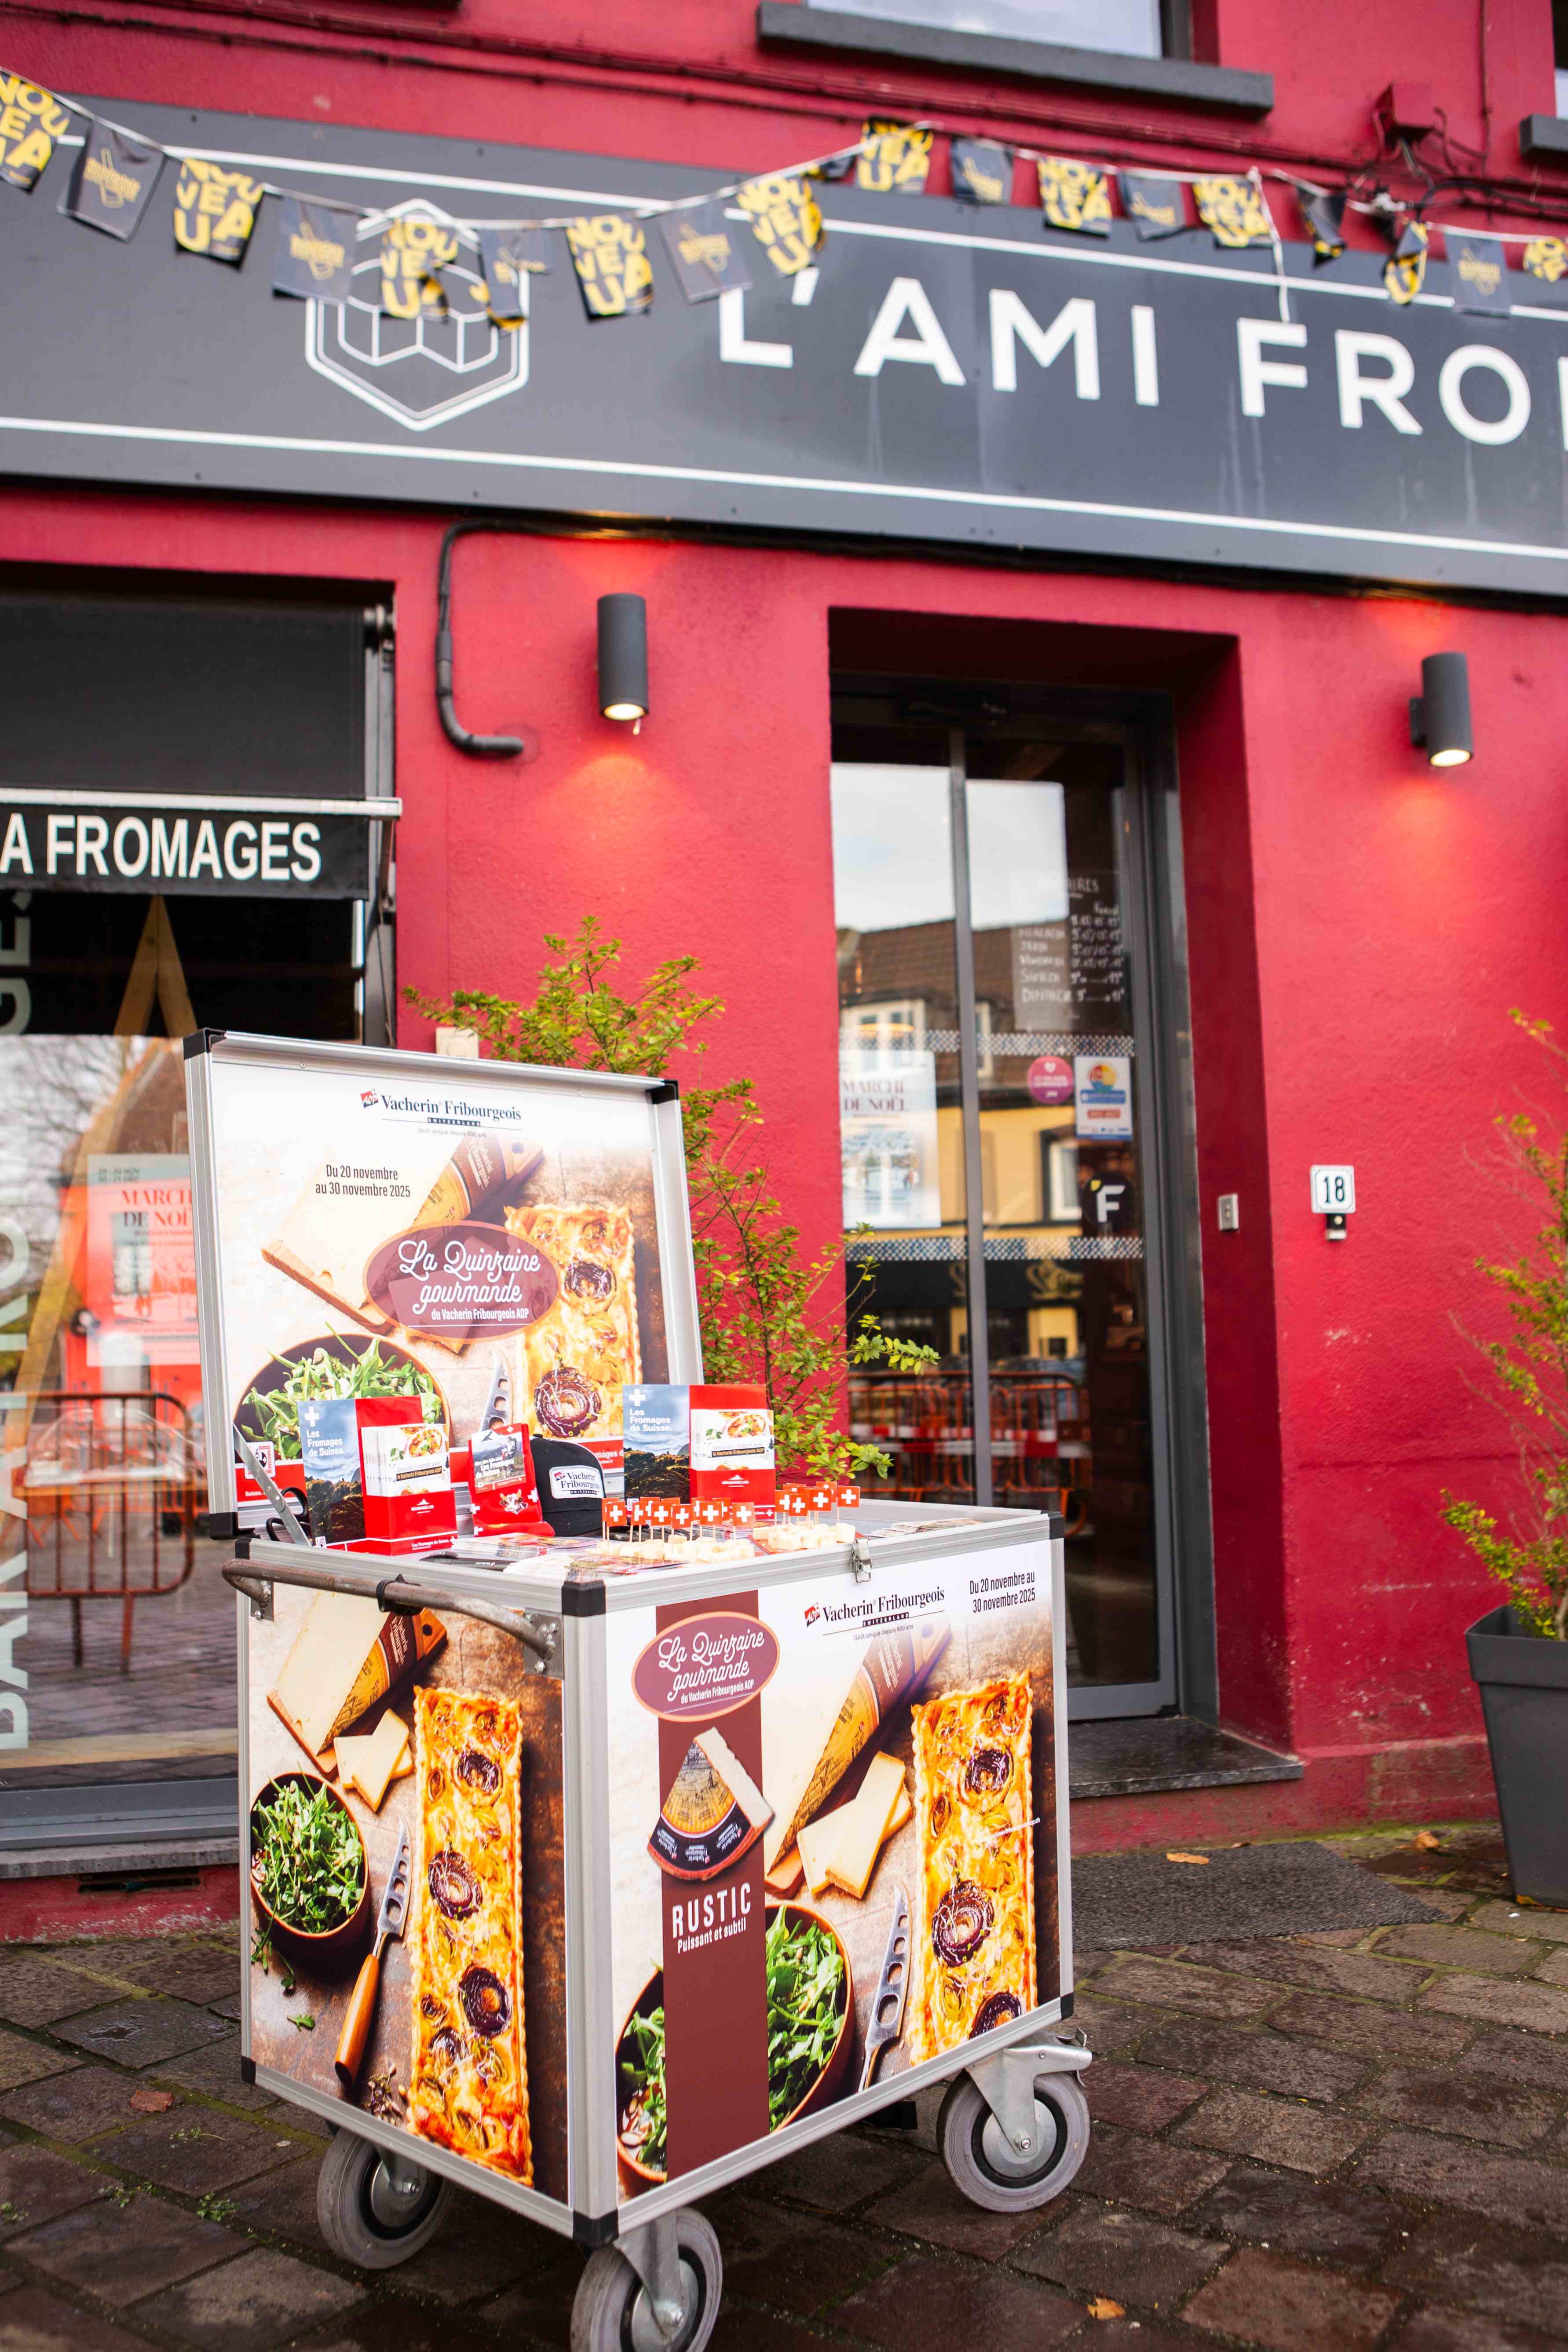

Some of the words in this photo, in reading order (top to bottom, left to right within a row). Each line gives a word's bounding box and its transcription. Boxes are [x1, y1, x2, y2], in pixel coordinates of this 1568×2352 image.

[1236, 317, 1568, 451] FRO
[46, 815, 322, 882] FROMAGES
[445, 1100, 521, 1122] Fribourgeois
[428, 1118, 480, 1127] SWITZERLAND
[326, 1164, 338, 1177] Du
[340, 1165, 351, 1178] 20
[353, 1167, 398, 1180] novembre
[122, 1189, 192, 1205] MARCH
[315, 1184, 327, 1194] au
[329, 1182, 340, 1195] 30
[343, 1183, 387, 1196] novembre
[389, 1185, 410, 1197] 2025
[1323, 1174, 1345, 1204] 18
[123, 1211, 148, 1227] DE
[398, 1240, 438, 1281] La
[443, 1240, 541, 1283] Quinzaine
[412, 1273, 523, 1315] gourmande
[431, 1309, 441, 1320] du
[441, 1308, 472, 1320] Vacherin
[473, 1308, 515, 1322] Fribourgeois
[516, 1308, 529, 1319] AOP
[629, 1416, 671, 1426] Fromages
[306, 1429, 320, 1438] Les
[307, 1438, 343, 1448] Fromages
[308, 1449, 318, 1457] de
[319, 1447, 346, 1456] Suisse.
[969, 1580, 979, 1595] Du
[980, 1578, 989, 1593] 20
[991, 1572, 1025, 1591] novembre
[1026, 1572, 1035, 1584] au
[878, 1586, 945, 1614] Fribourgeois
[972, 1598, 982, 1613] 30
[983, 1592, 1018, 1612] novembre
[1019, 1588, 1036, 1604] 2025
[863, 1611, 909, 1627] SWITZERLAND
[854, 1633, 865, 1642] Goût
[866, 1630, 881, 1640] unique
[881, 1628, 896, 1636] depuis
[658, 1635, 687, 1673] La
[691, 1628, 765, 1666] Quinzaine
[667, 1650, 750, 1702] gourmande
[681, 1693, 688, 1705] du
[689, 1689, 712, 1703] Vacherin
[712, 1681, 744, 1698] Fribourgeois
[744, 1679, 754, 1690] AOP
[672, 1882, 751, 1939] RUSTIC
[677, 1929, 713, 1954] Puissant
[714, 1925, 722, 1941] et
[724, 1916, 746, 1938] subtil
